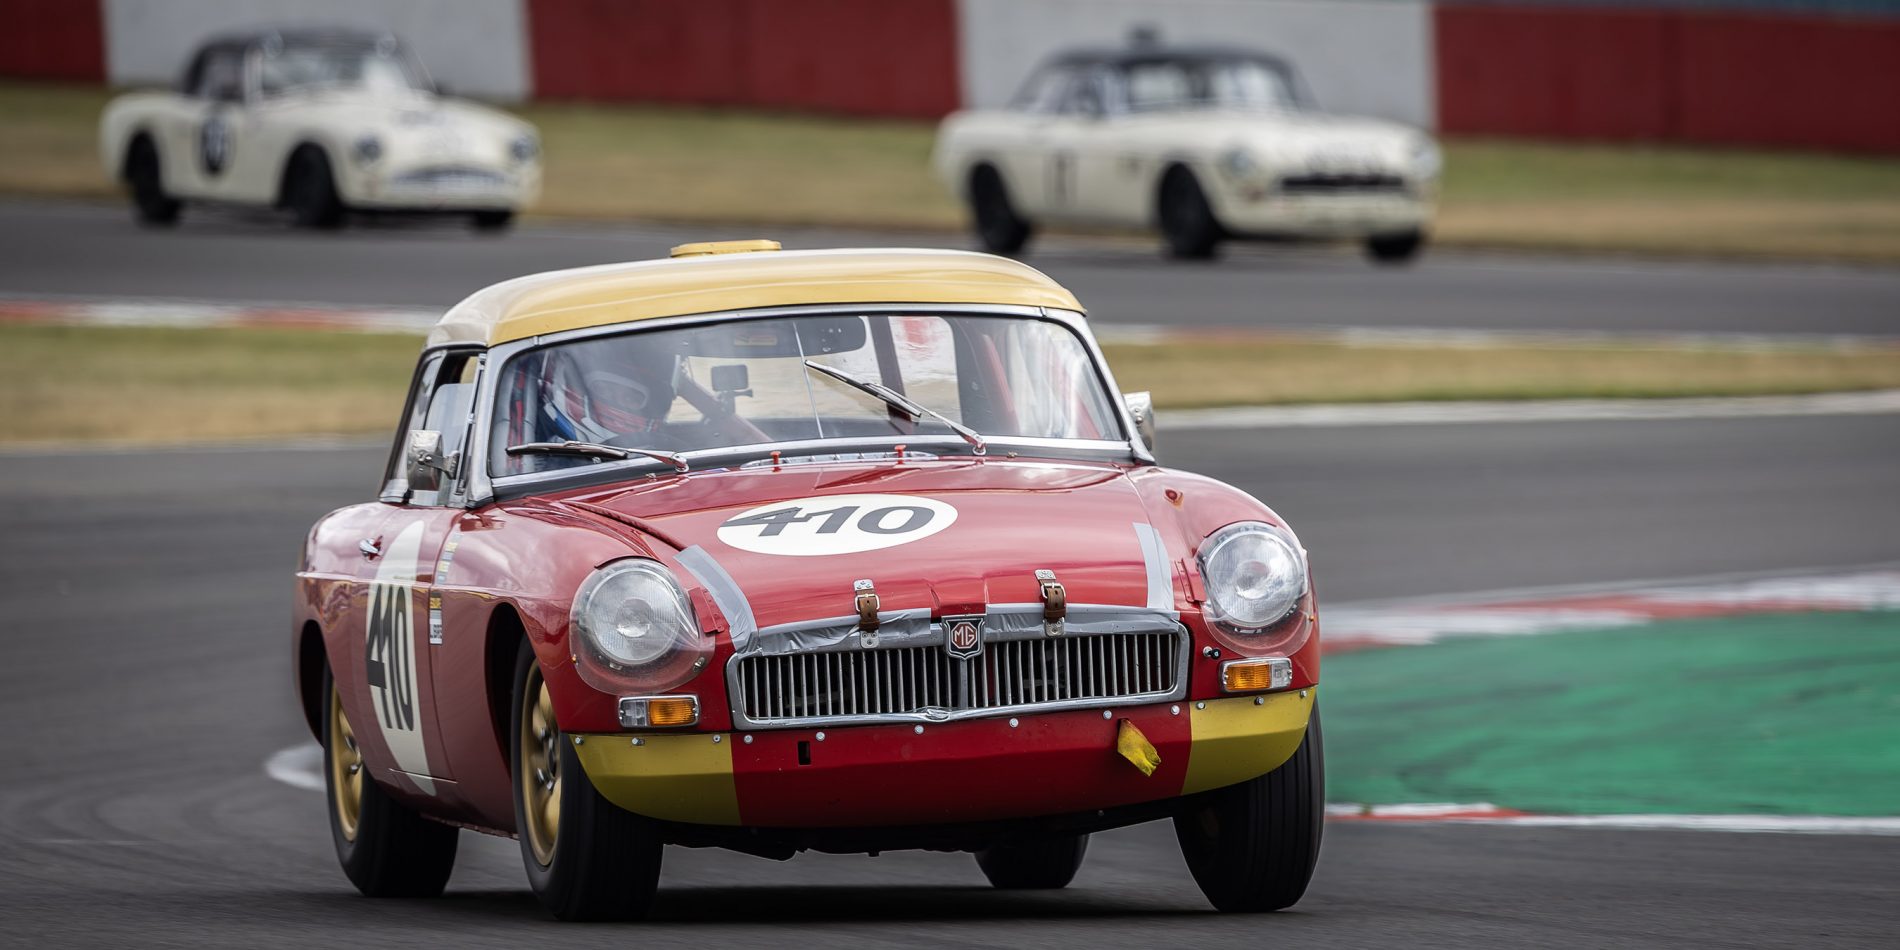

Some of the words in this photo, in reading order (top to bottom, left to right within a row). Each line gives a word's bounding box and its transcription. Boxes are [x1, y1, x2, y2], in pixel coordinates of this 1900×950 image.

[720, 505, 936, 537] 410
[954, 625, 975, 646] MG
[366, 583, 415, 732] 410
